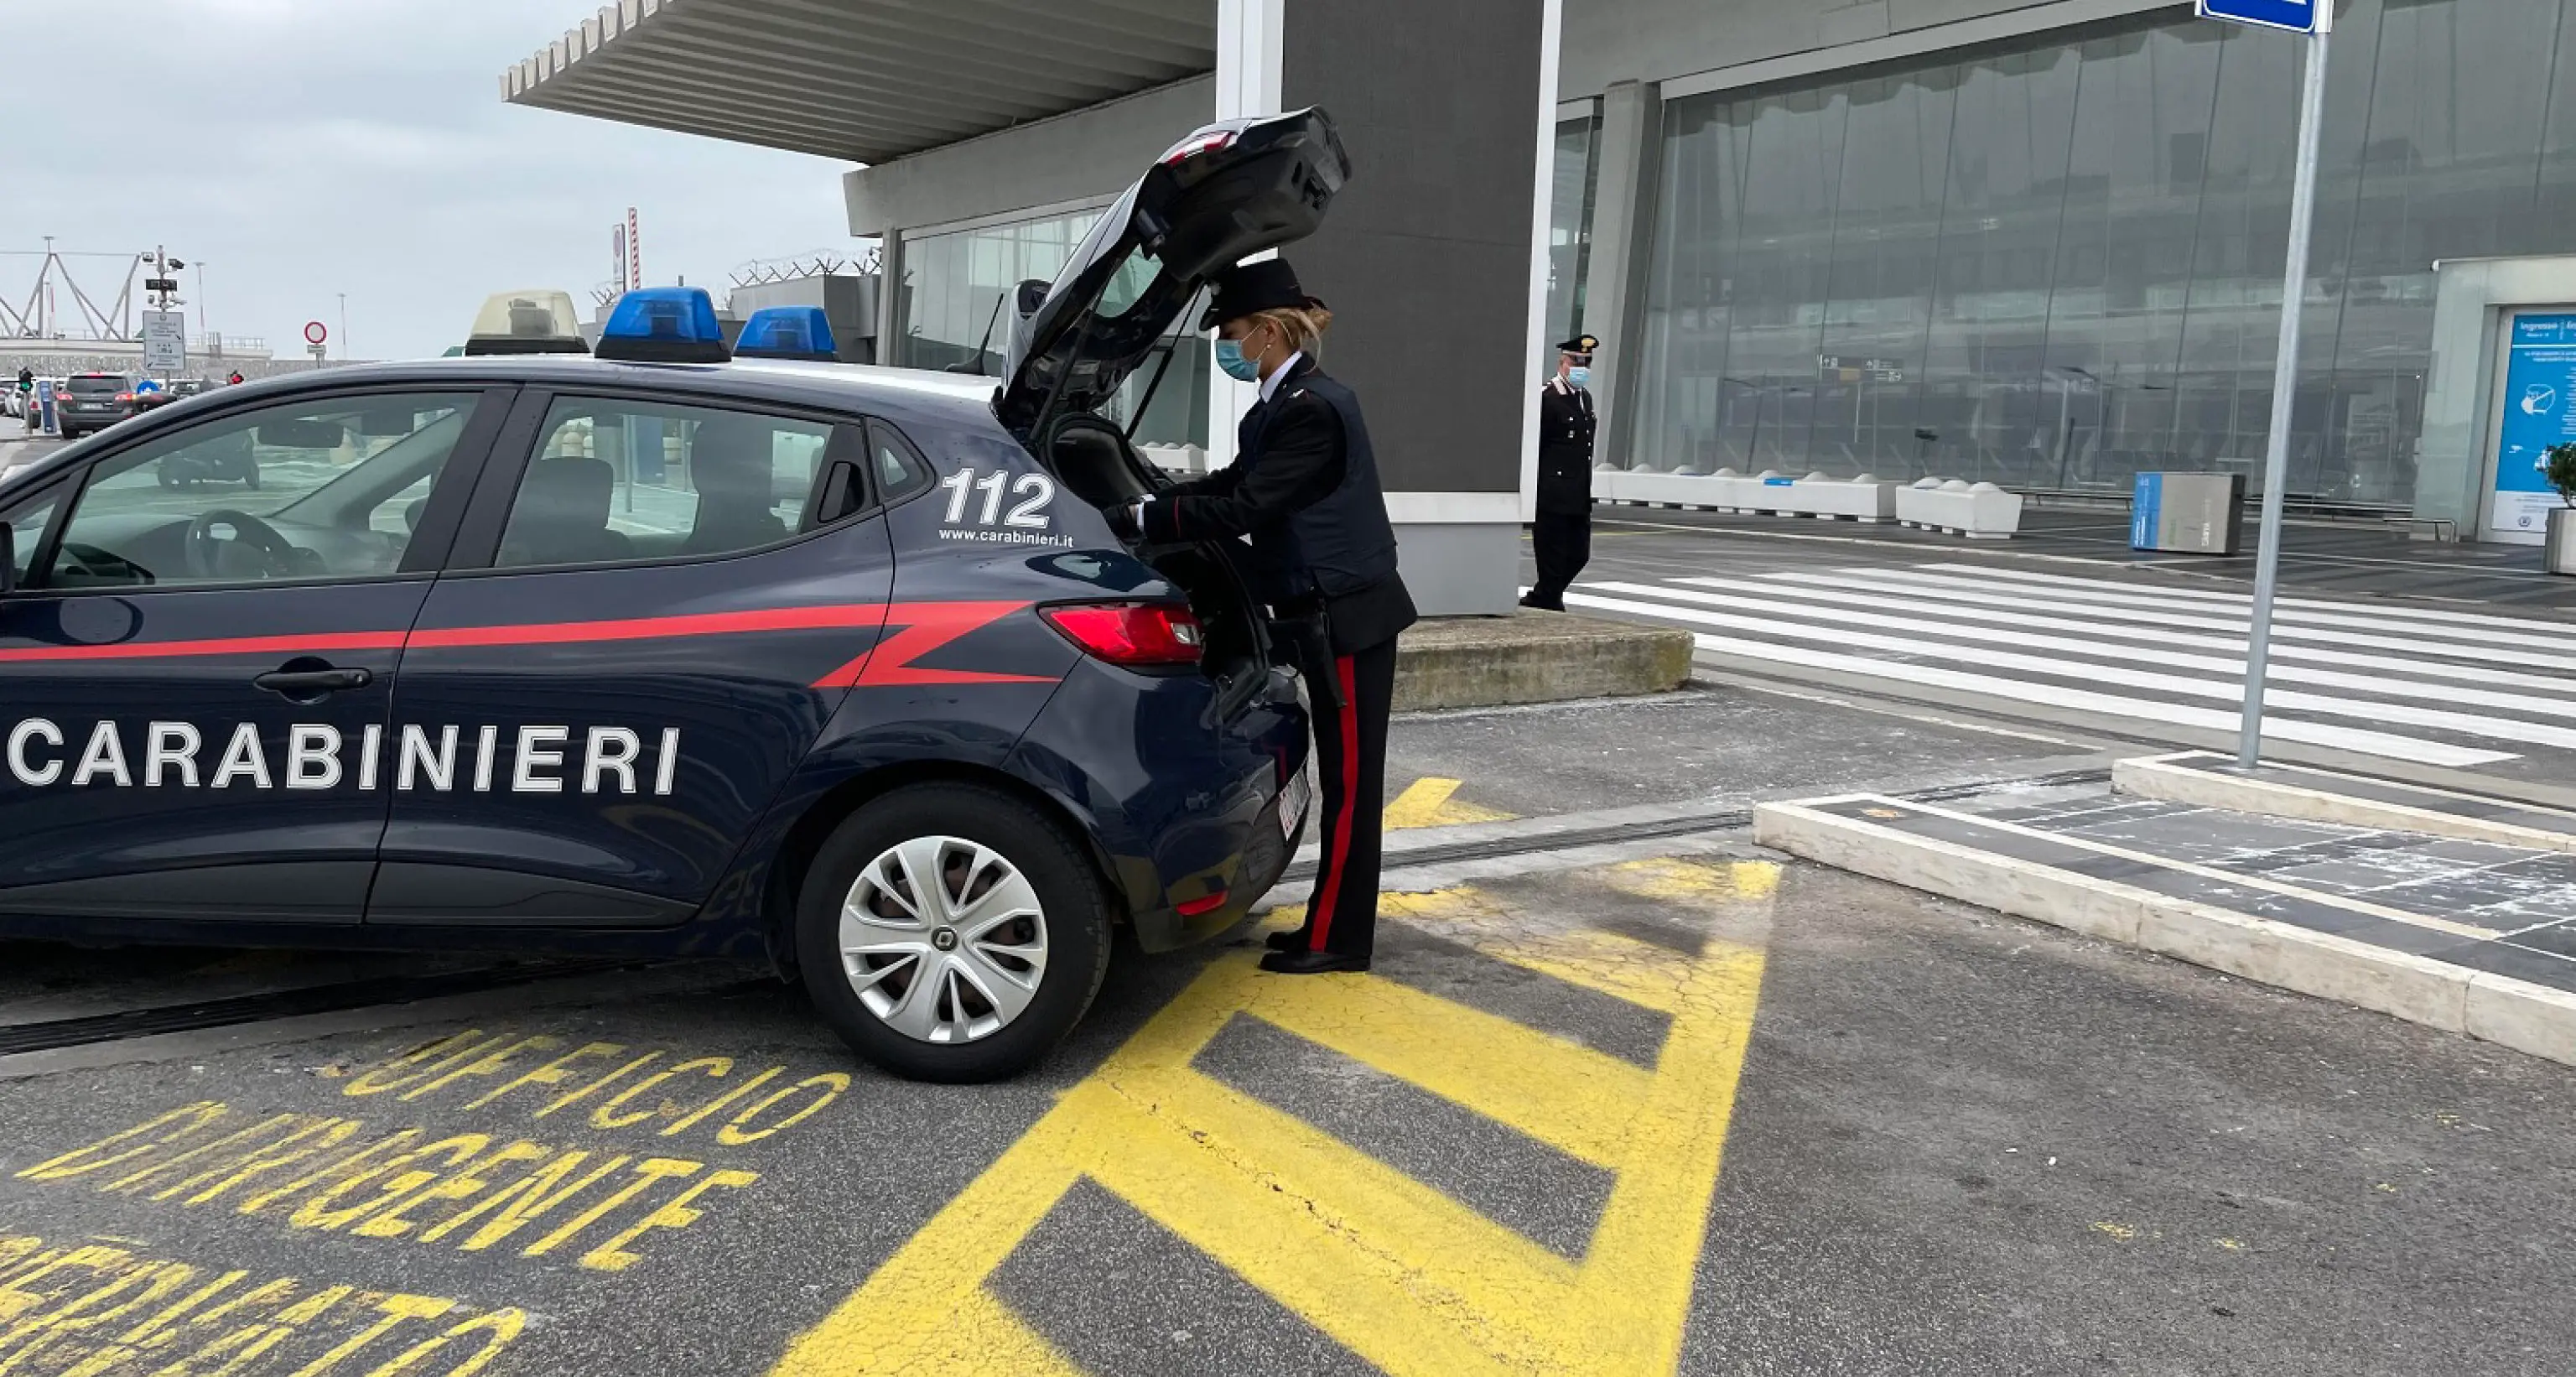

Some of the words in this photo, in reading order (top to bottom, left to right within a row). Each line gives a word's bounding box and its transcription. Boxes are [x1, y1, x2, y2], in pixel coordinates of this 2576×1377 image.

[942, 467, 1056, 529] 112
[938, 528, 1074, 548] www.carabinieri.it
[6, 717, 681, 796] CARABINIERI
[344, 1028, 851, 1146] UFFICIO
[15, 1100, 759, 1271] DIRIGENTE
